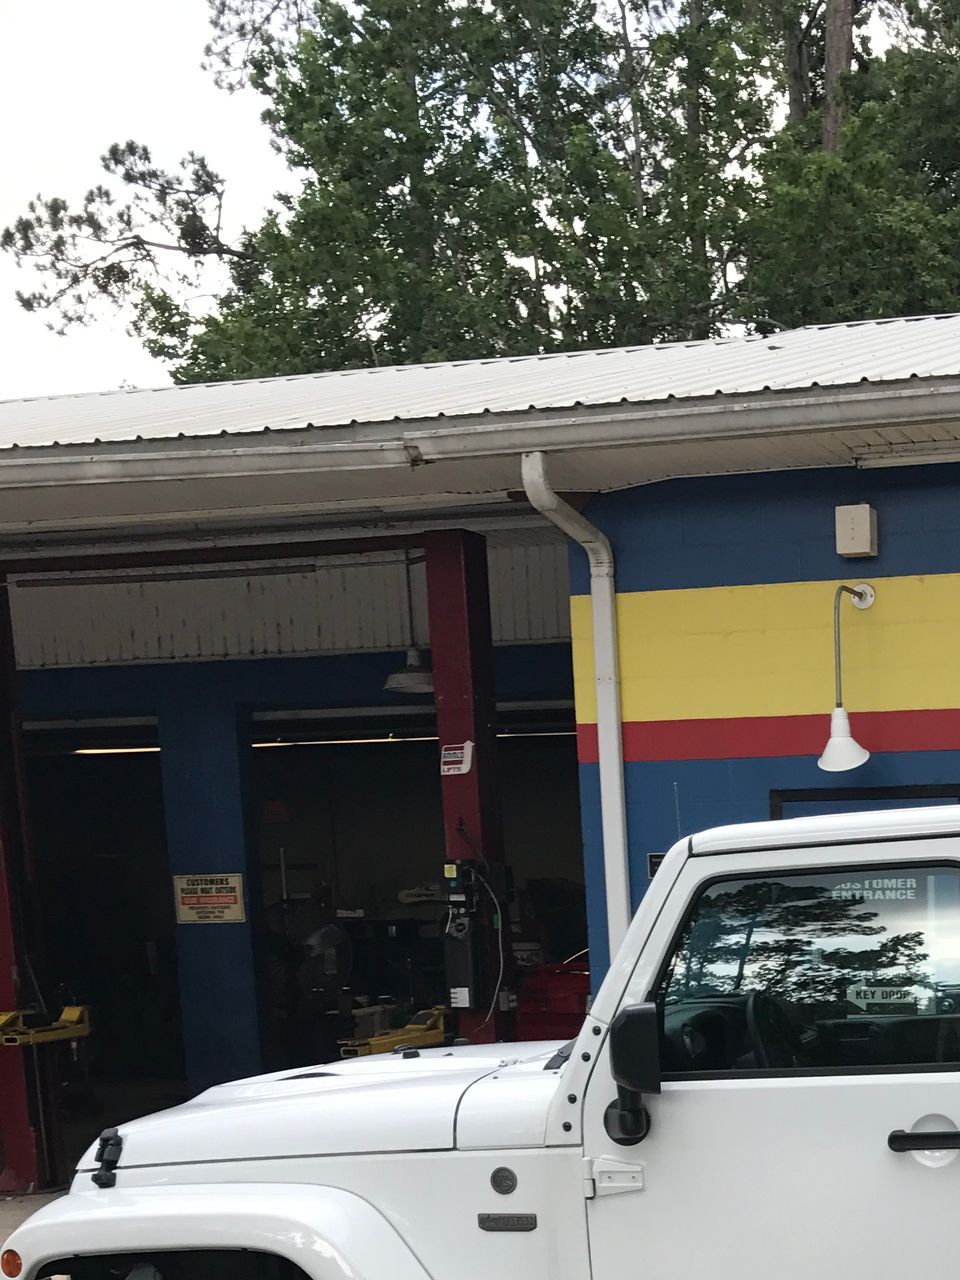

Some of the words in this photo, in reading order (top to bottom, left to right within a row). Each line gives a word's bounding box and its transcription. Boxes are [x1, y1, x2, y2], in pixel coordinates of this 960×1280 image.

[186, 878, 229, 886] CUSTOMERS
[832, 890, 916, 900] ENTRANCE
[855, 989, 876, 999] KEY
